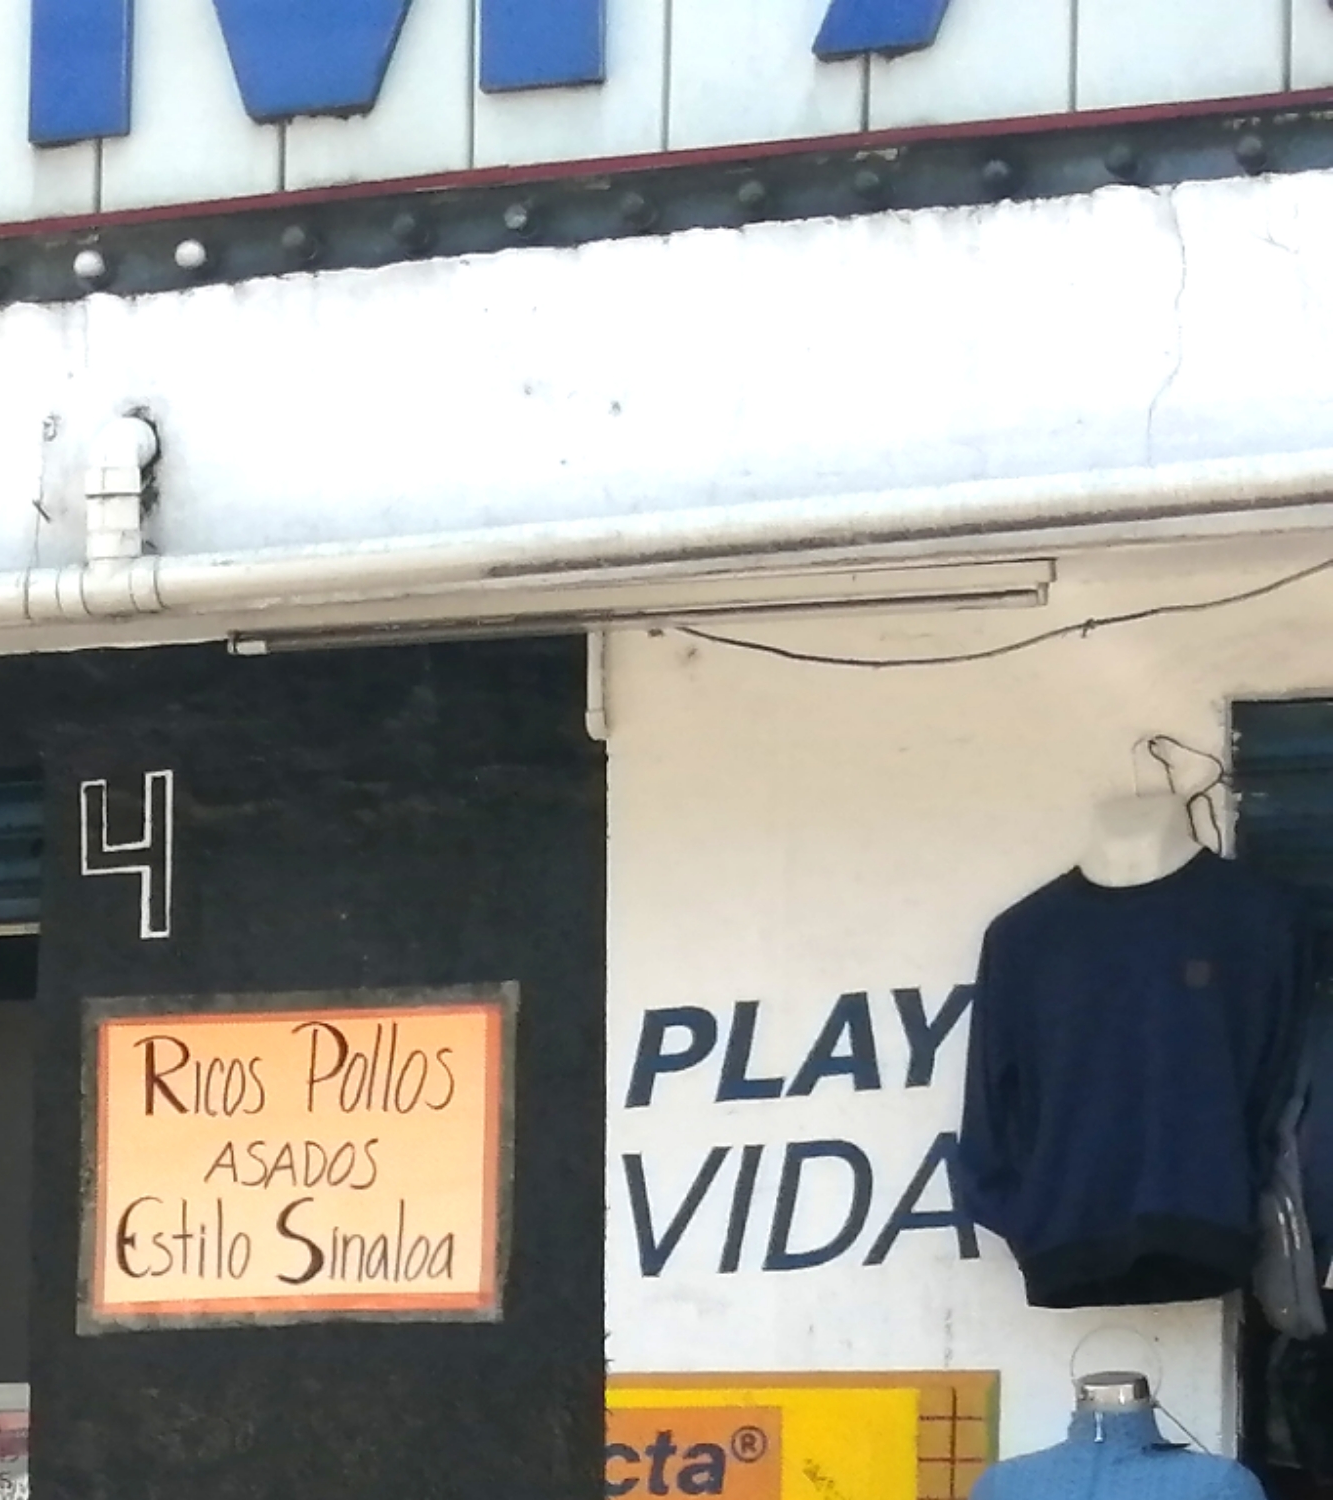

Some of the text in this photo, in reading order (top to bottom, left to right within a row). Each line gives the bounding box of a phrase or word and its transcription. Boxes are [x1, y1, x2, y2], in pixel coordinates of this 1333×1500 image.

[80, 769, 173, 938] 4
[291, 1020, 456, 1115] Pollos
[204, 1137, 379, 1191] ASADOS
[621, 1131, 981, 1278] VIDA
[115, 1196, 455, 1285] Estilo Sinaloa
